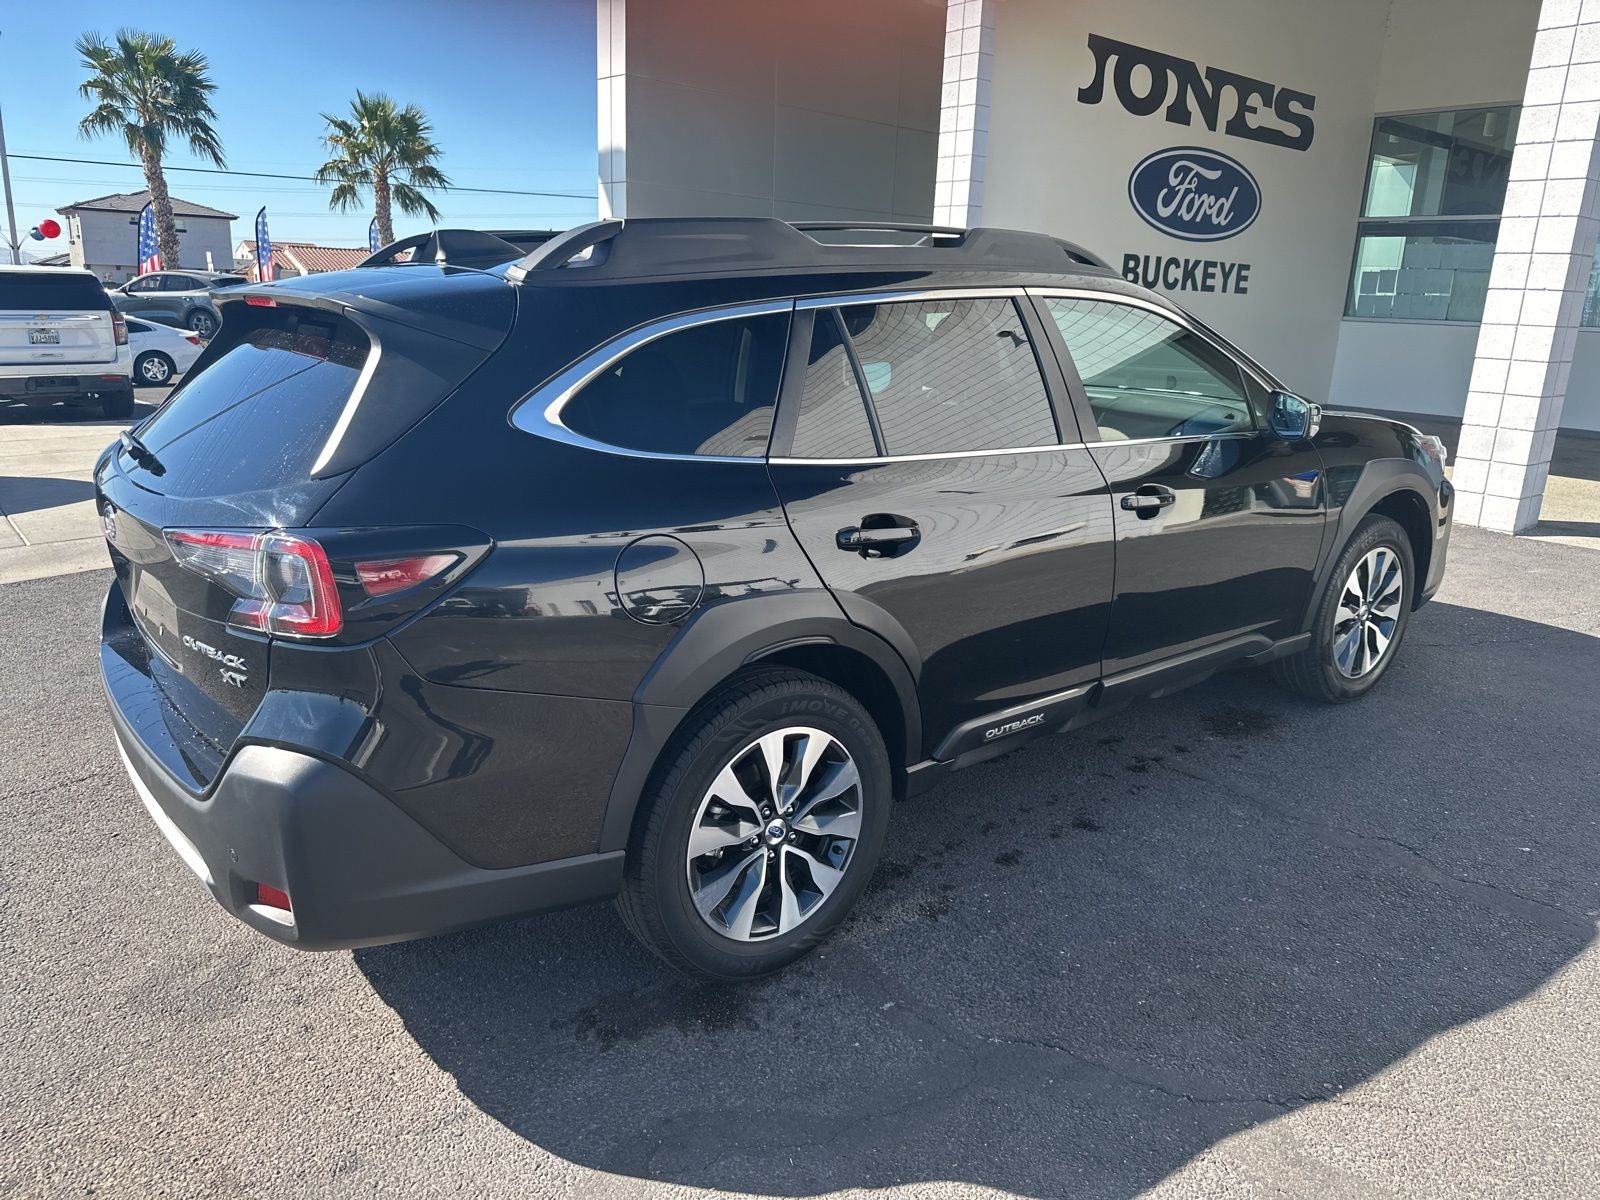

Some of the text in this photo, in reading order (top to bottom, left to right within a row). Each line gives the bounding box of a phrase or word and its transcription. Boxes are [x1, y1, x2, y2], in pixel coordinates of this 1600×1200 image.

[1078, 33, 1316, 152] JONES
[1156, 159, 1239, 226] Ford
[1122, 253, 1251, 294] BUCKEYE
[182, 635, 247, 670] OUTBACK
[219, 668, 248, 688] XT
[985, 713, 1044, 738] OUTBACK
